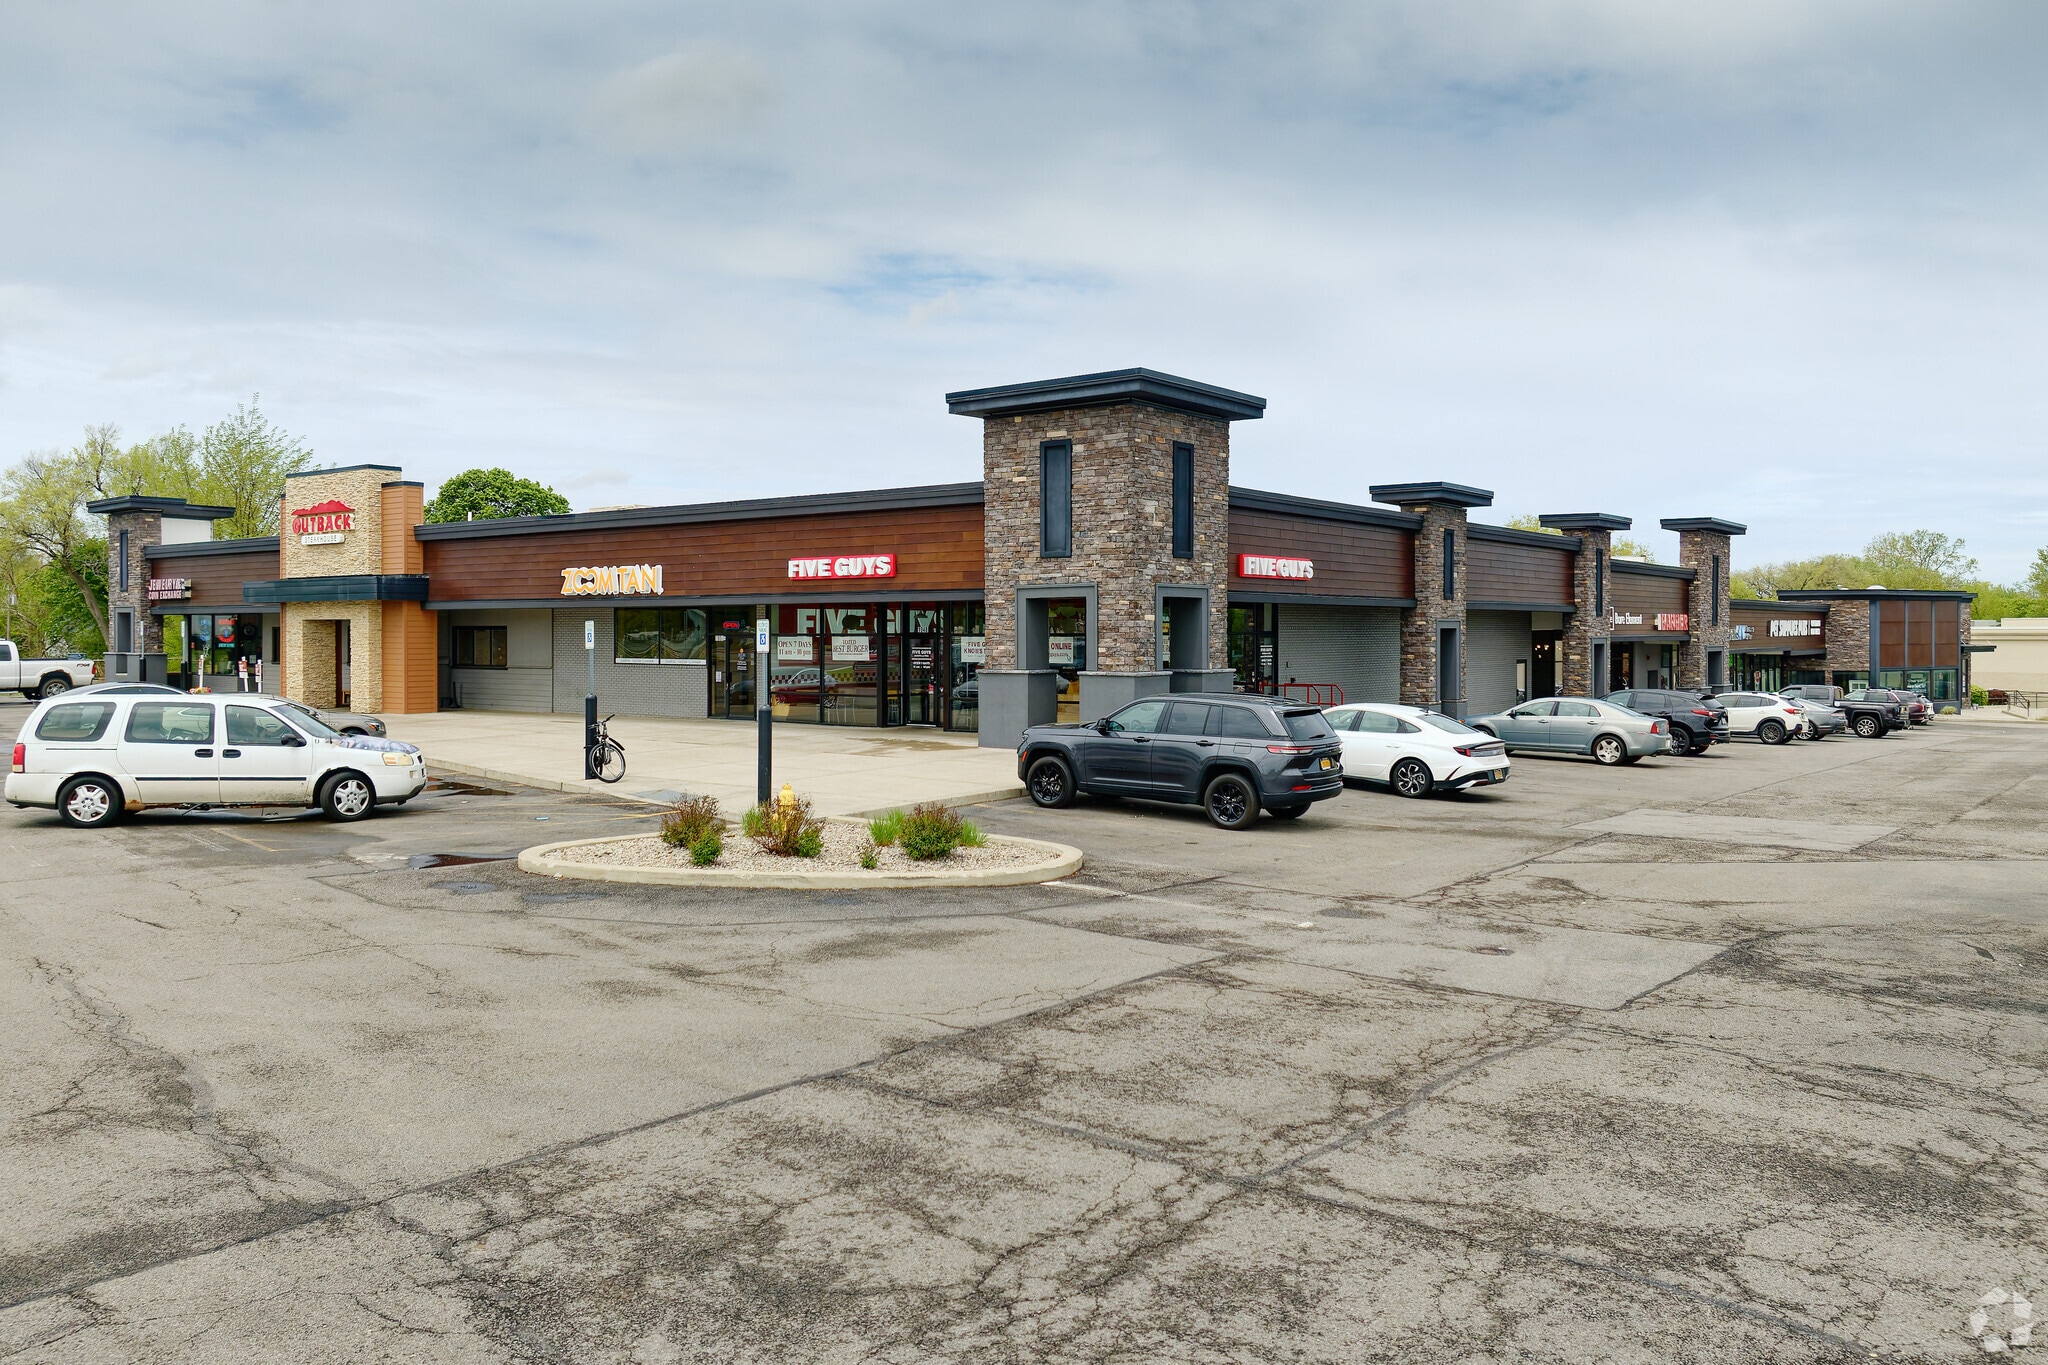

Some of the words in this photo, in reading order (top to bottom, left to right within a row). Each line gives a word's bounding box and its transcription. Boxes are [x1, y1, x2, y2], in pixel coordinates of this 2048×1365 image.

[292, 514, 352, 534] OUTBACK
[788, 558, 832, 578] FIVE
[834, 556, 891, 577] GUYS
[1243, 556, 1276, 576] FIVE
[1276, 559, 1314, 579] GUYS
[148, 578, 176, 590] JEWELRY
[560, 566, 618, 596] ZOOM
[616, 564, 663, 595] TAN
[148, 591, 159, 600] COIN
[160, 590, 182, 599] EXCHANGE
[796, 608, 866, 634] FIVE
[778, 640, 793, 648] OPEN
[798, 640, 812, 648] DAYS
[833, 645, 845, 653] BEST
[846, 645, 869, 653] BURGER
[1051, 642, 1072, 650] ONLINE
